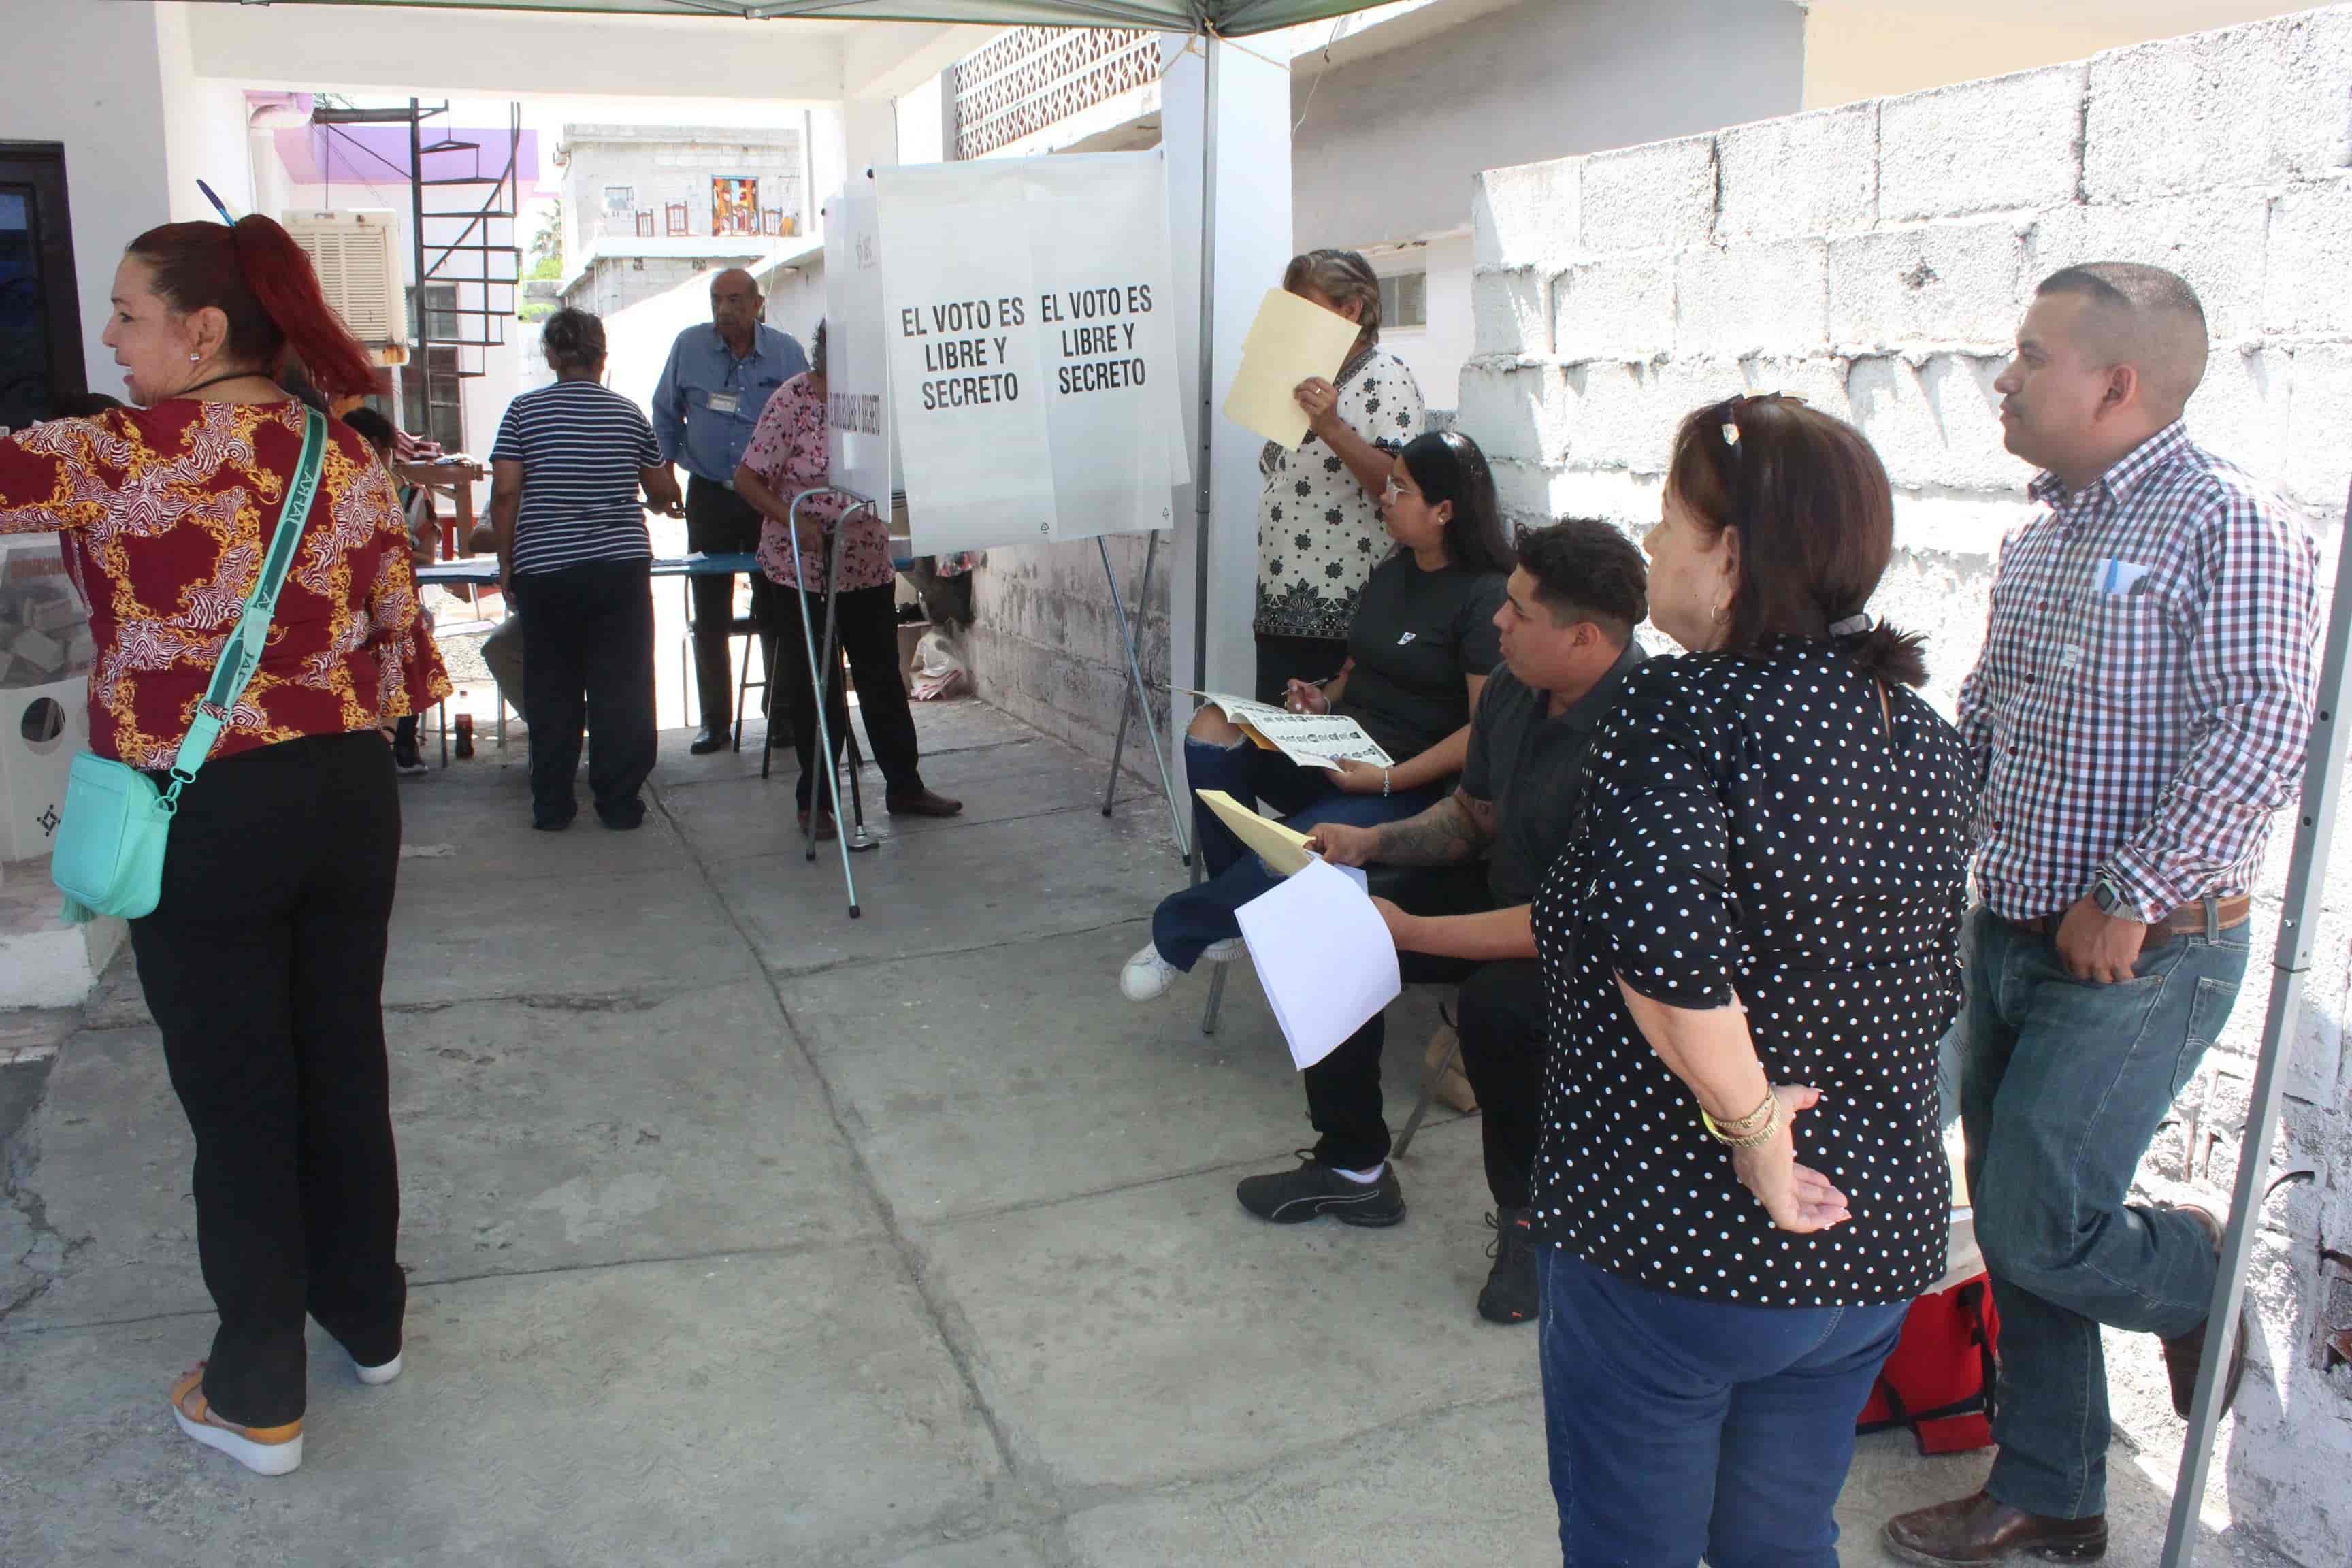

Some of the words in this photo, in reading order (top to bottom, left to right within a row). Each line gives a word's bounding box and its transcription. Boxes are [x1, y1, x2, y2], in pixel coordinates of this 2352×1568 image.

[902, 307, 928, 338] EL
[932, 299, 991, 333] VOTO
[998, 297, 1025, 327] ES
[1041, 293, 1064, 323] EL
[1068, 287, 1121, 320] VOTO
[1127, 284, 1153, 314] ES
[925, 338, 988, 372] LIBRE
[993, 336, 1007, 365] Y
[1062, 324, 1118, 357] LIBRE
[1122, 322, 1135, 350] Y
[921, 372, 1019, 410] SECRETO
[1058, 357, 1146, 395] SECRETO
